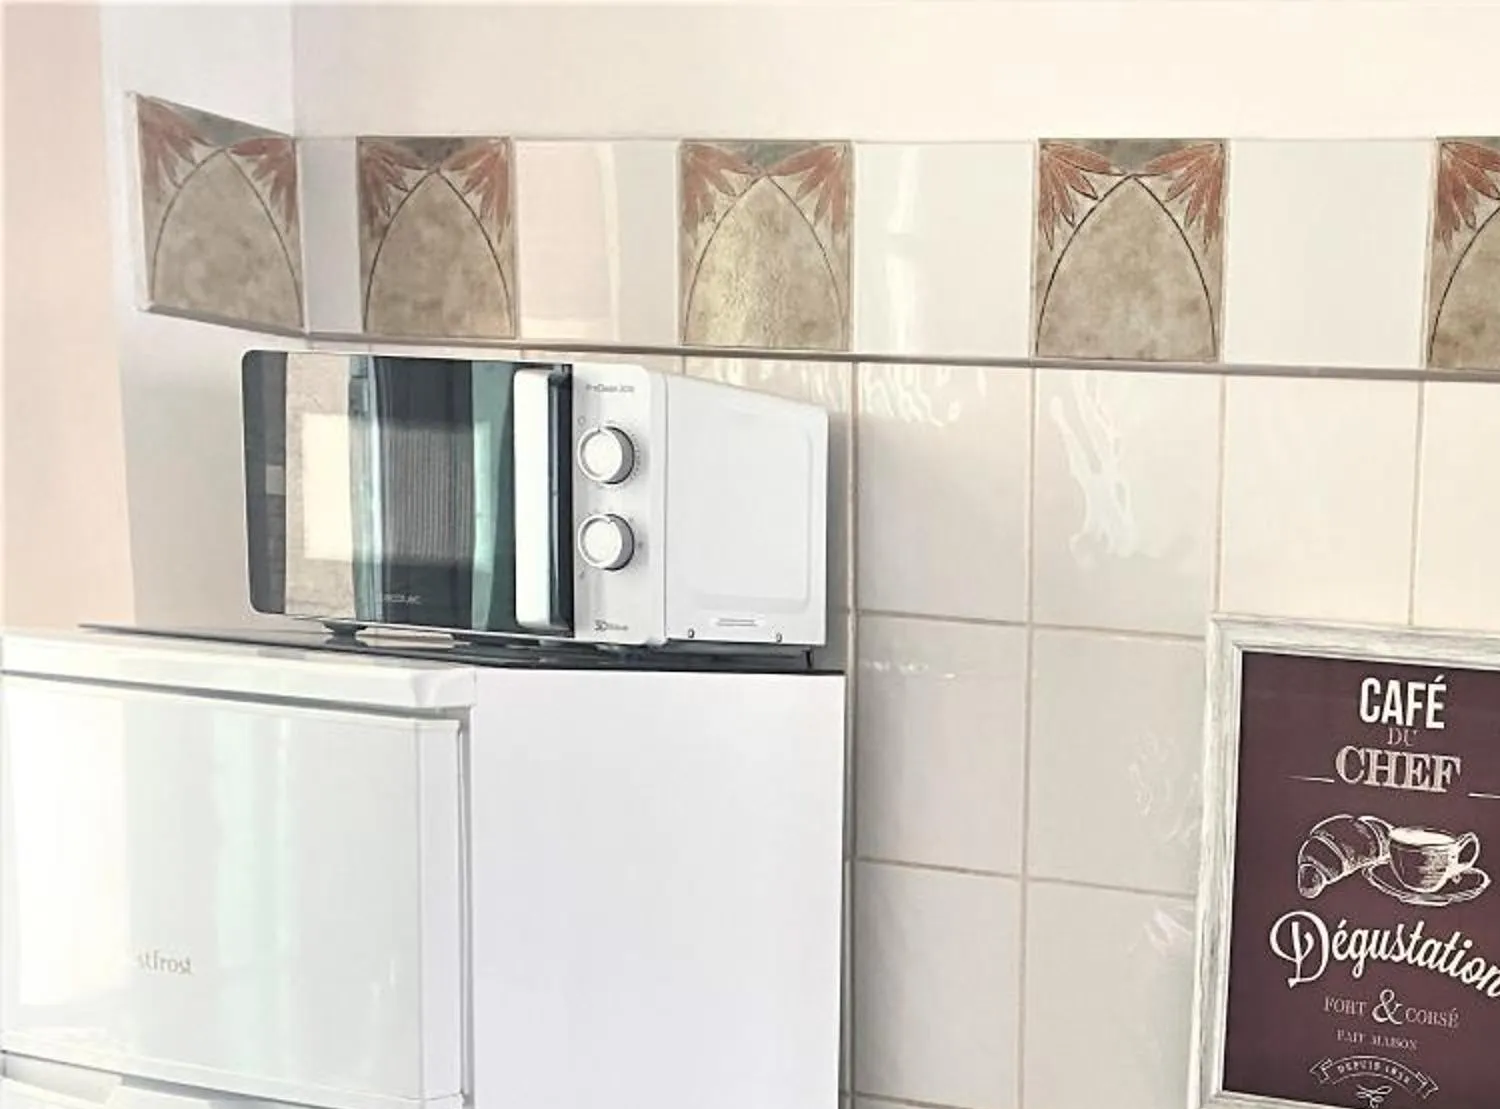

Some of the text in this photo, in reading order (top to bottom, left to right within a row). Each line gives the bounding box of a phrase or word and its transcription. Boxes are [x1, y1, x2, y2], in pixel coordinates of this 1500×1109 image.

[1359, 674, 1447, 729] CAFÉ
[1387, 727, 1418, 746] DU
[1335, 745, 1461, 793] CHEF
[1323, 989, 1459, 1029] FORT & CORSÉ
[1370, 1034, 1418, 1051] MAISON
